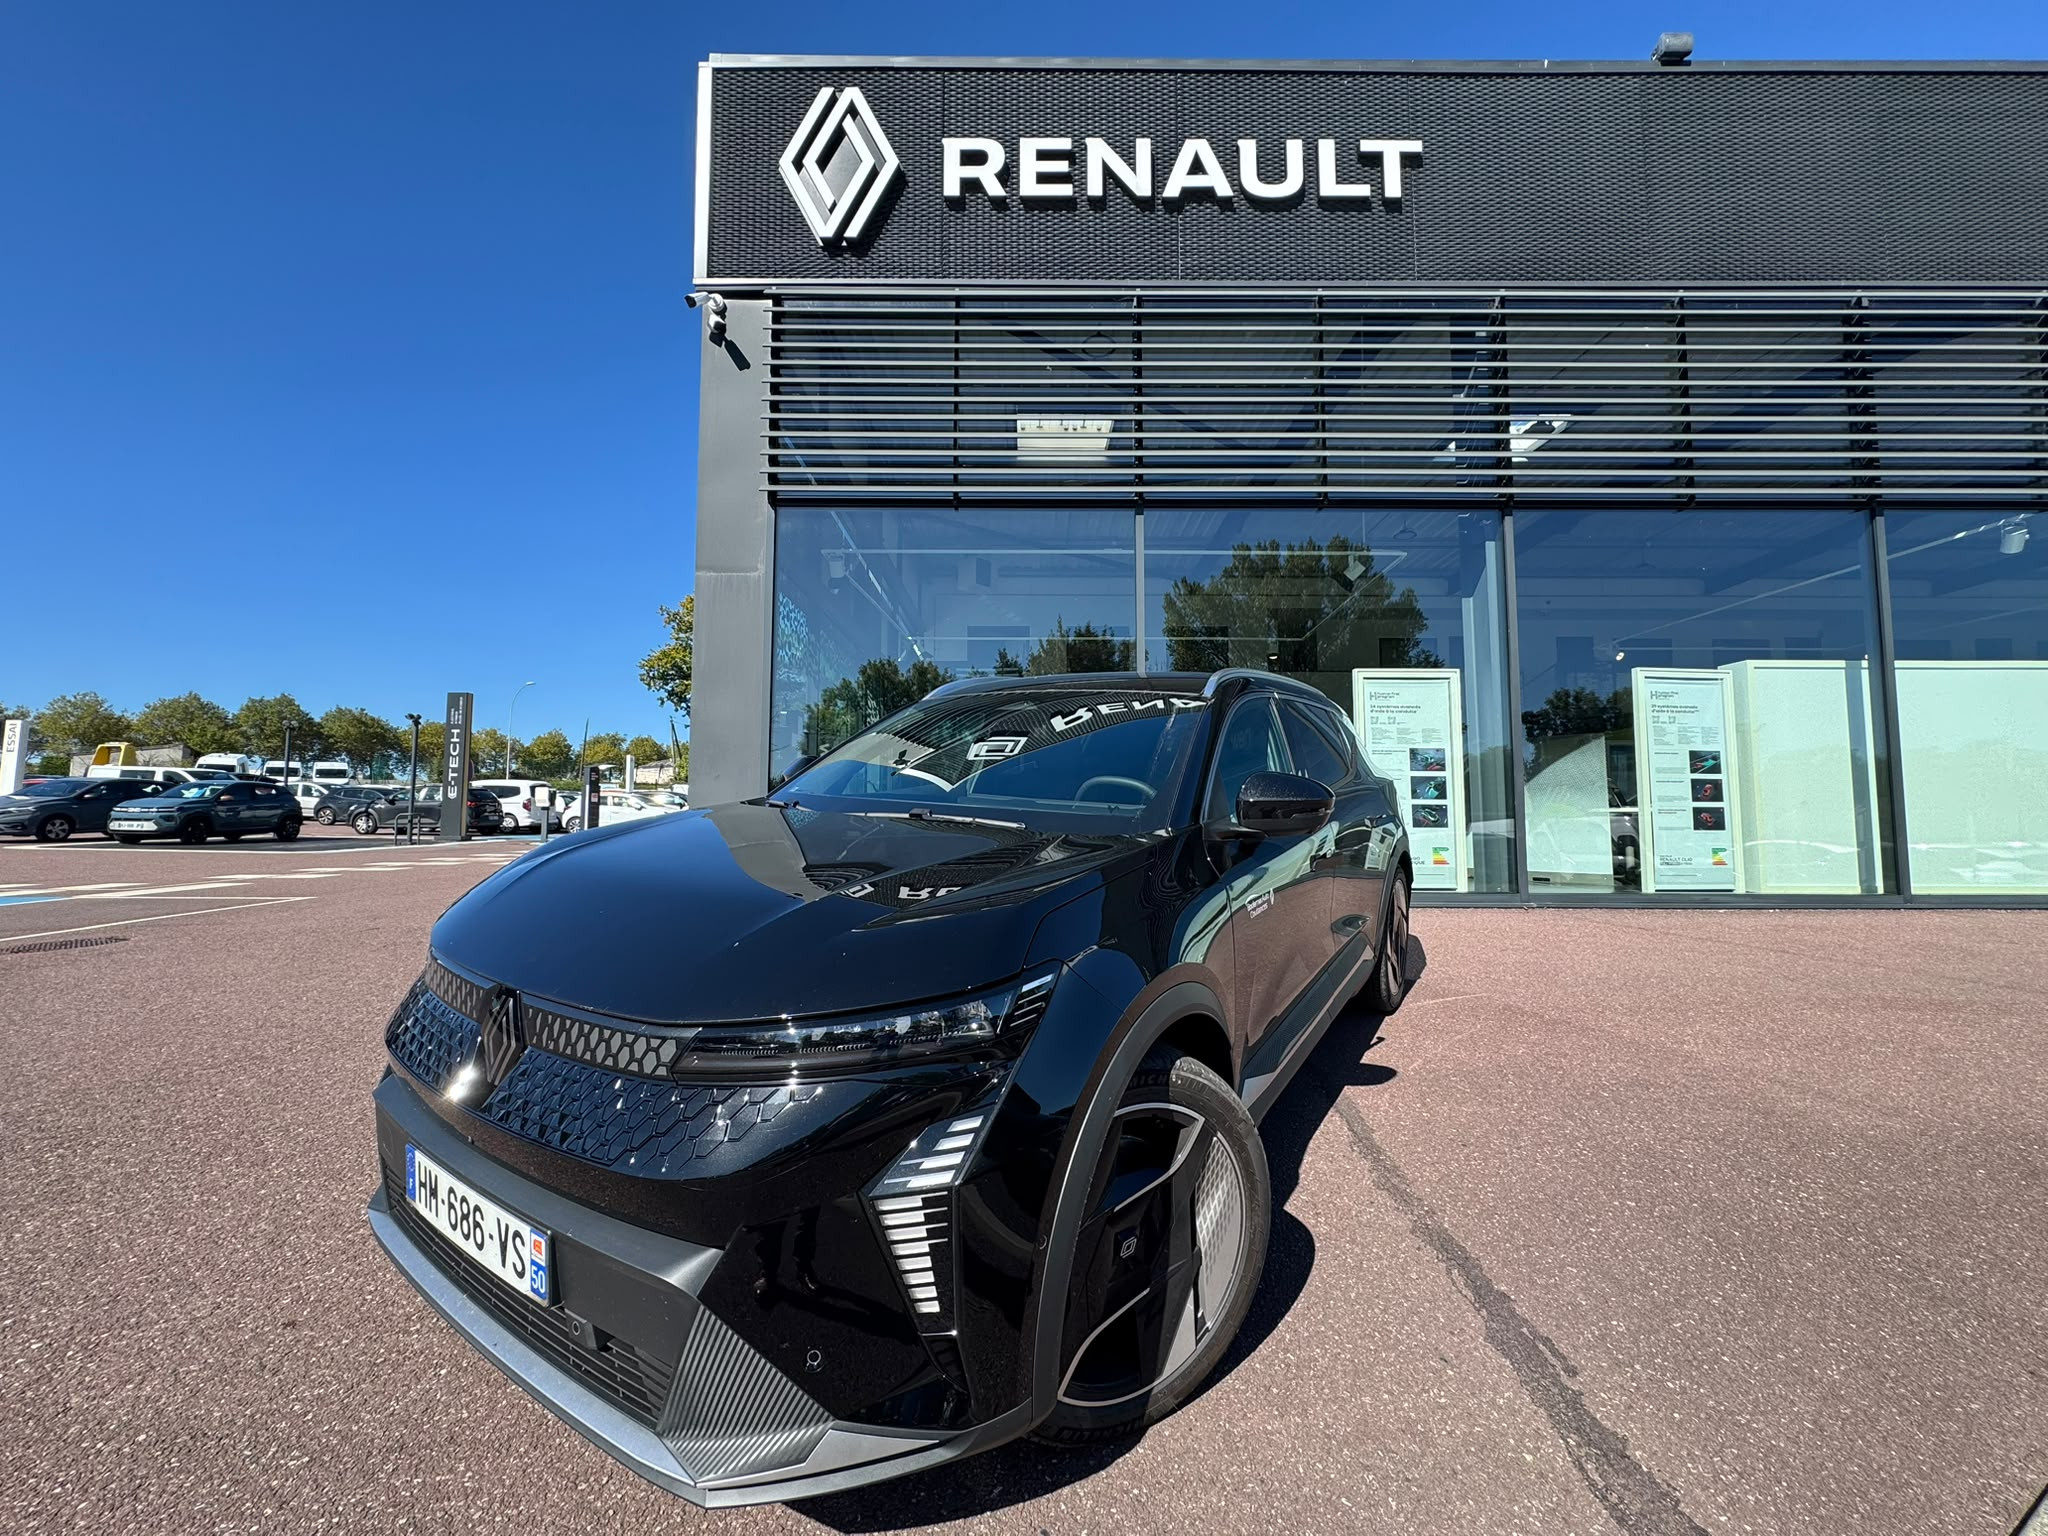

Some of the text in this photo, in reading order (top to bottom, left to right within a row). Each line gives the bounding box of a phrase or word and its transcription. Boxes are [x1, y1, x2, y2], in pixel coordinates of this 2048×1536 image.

[942, 137, 1423, 199] RENAULT
[6, 722, 18, 753] ESSAI
[447, 728, 461, 800] E-TECH
[409, 1178, 414, 1190] F
[418, 1161, 526, 1280] HM-686-VS
[531, 1266, 546, 1294] 50
